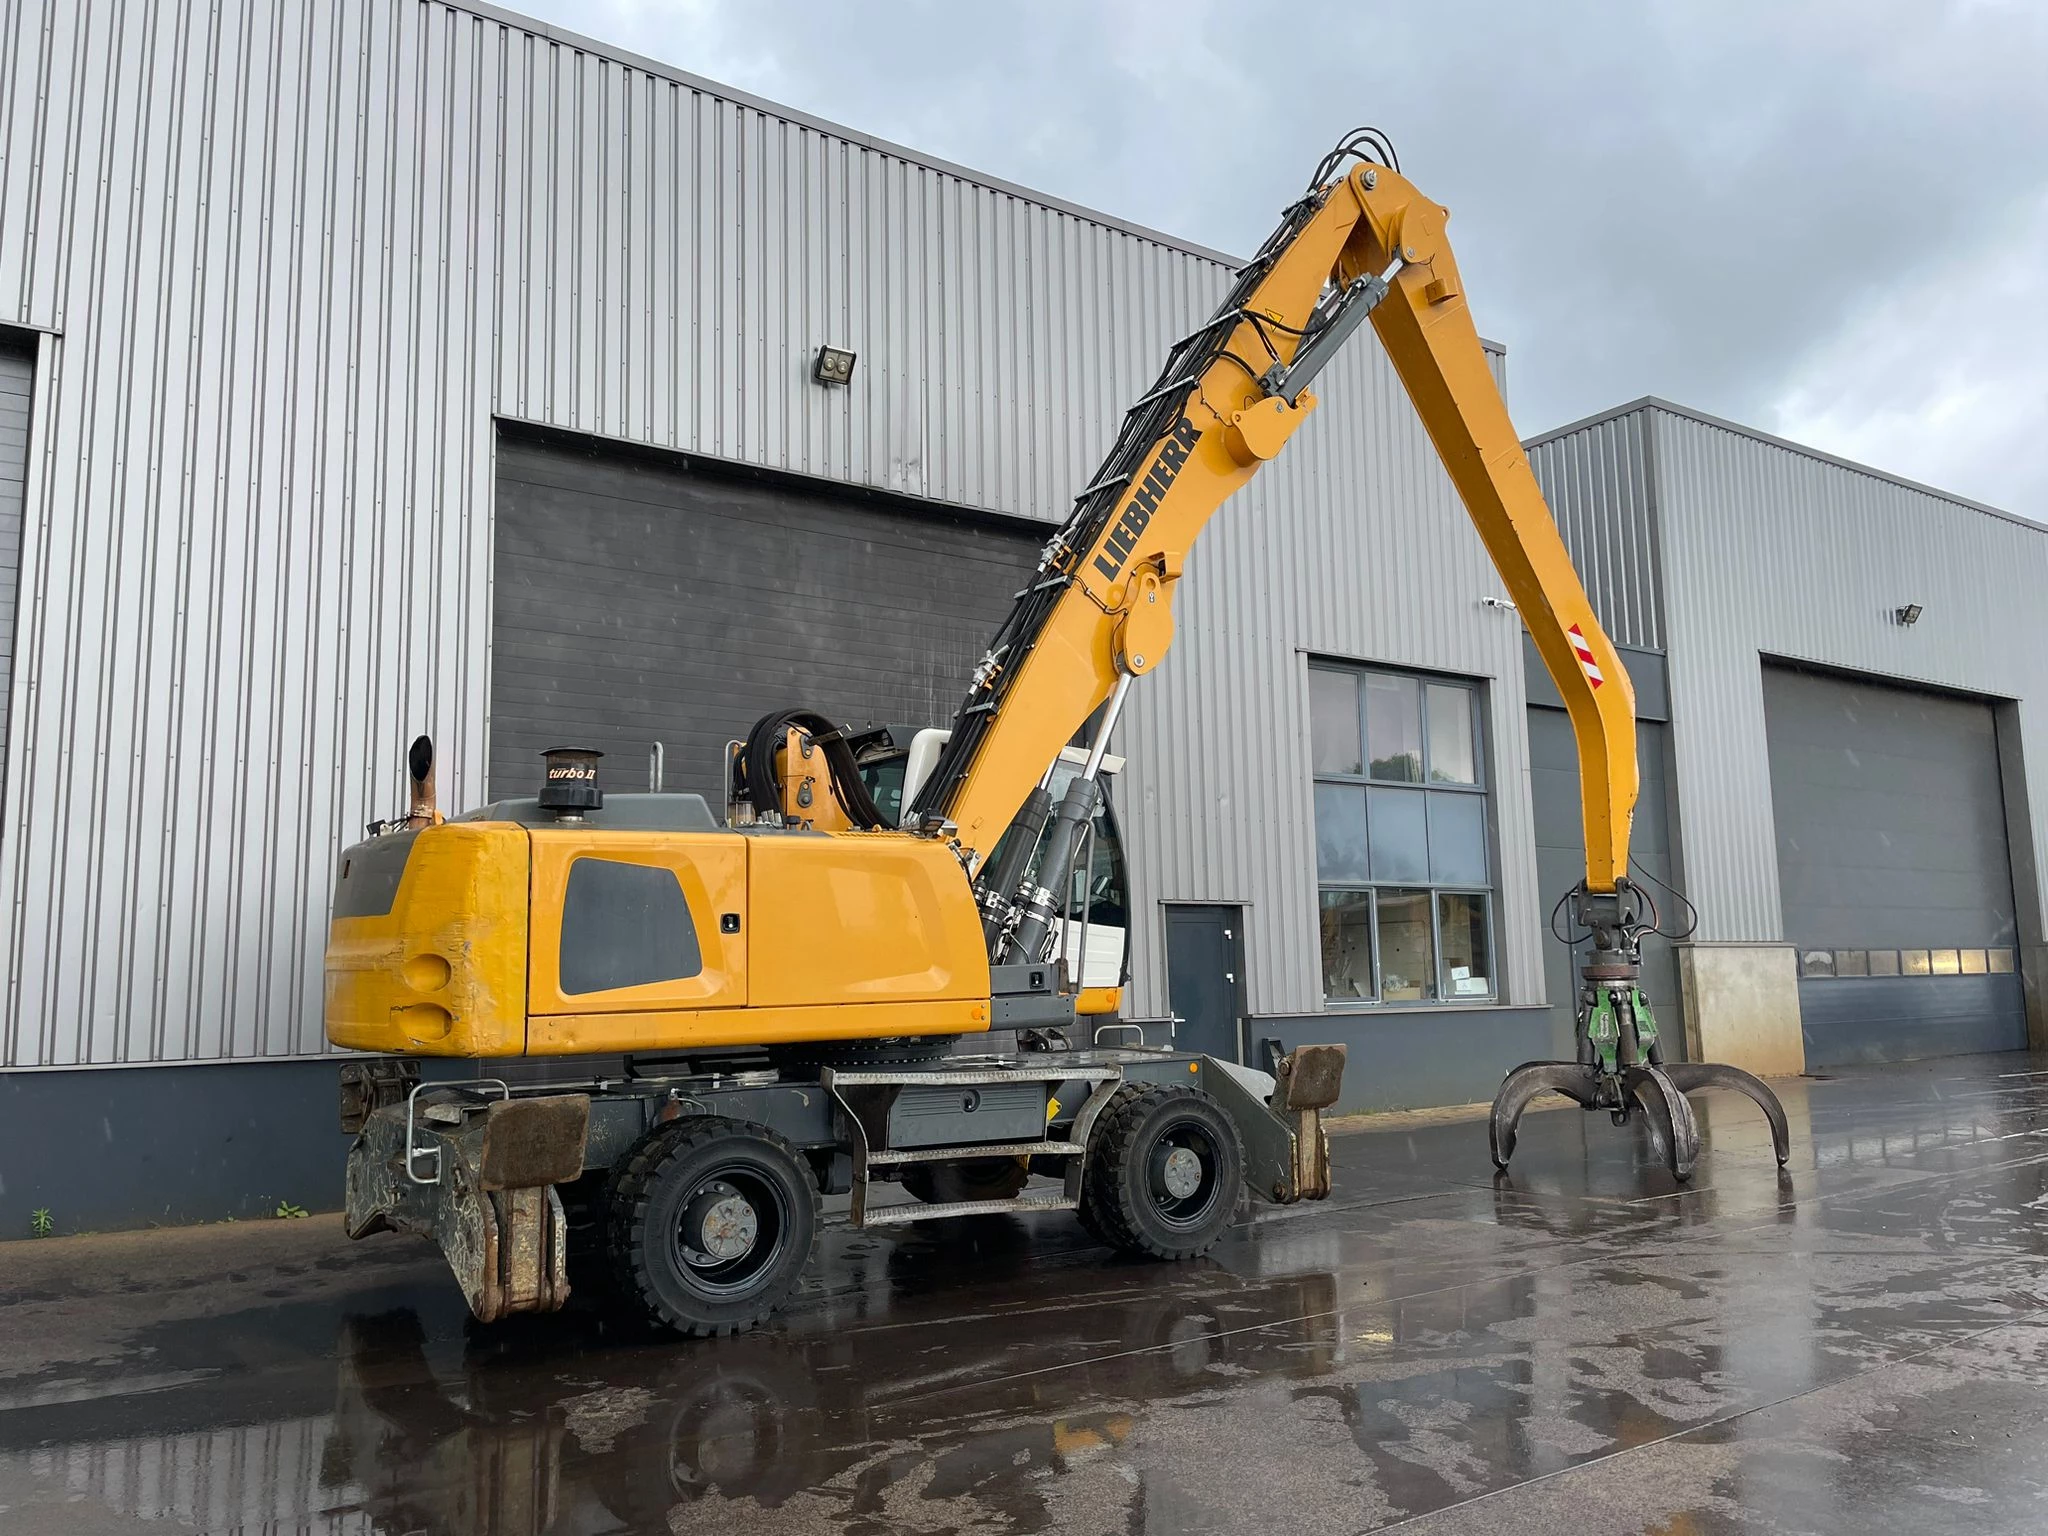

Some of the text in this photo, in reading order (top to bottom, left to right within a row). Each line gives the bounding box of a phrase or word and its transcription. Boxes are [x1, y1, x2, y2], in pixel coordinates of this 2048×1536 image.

[1093, 417, 1203, 582] LIEBHERR
[549, 768, 596, 780] turbo II
